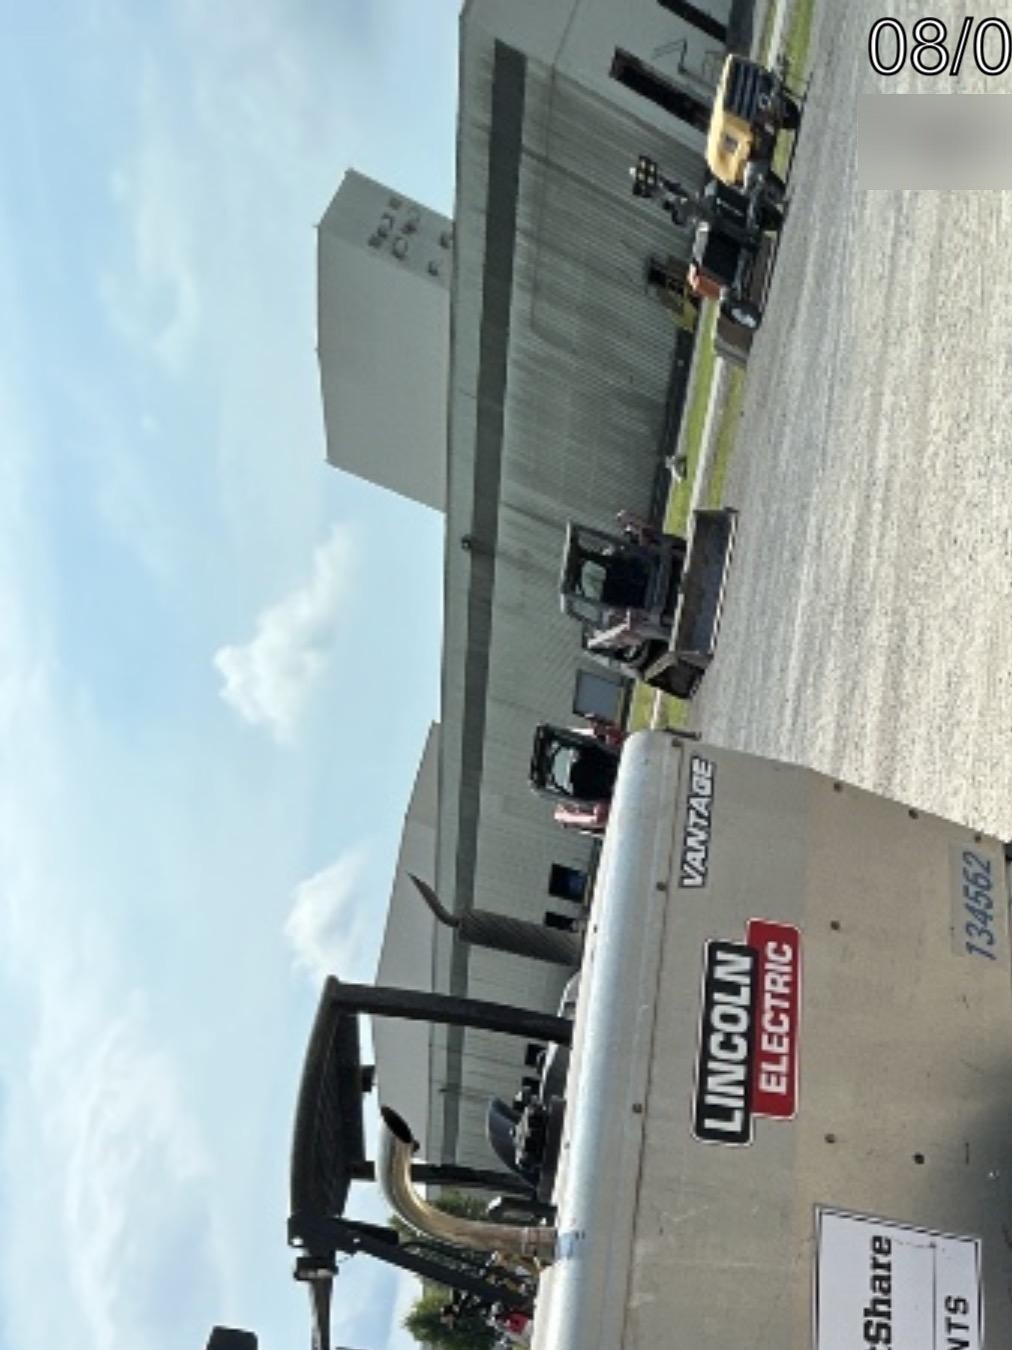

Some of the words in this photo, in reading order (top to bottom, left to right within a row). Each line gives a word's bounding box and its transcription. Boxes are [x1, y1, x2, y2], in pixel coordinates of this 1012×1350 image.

[682, 758, 713, 888] VANTAGE
[962, 850, 997, 961] 134562
[703, 951, 754, 1134] LINCOLN
[758, 941, 793, 1095] ELECTRIC
